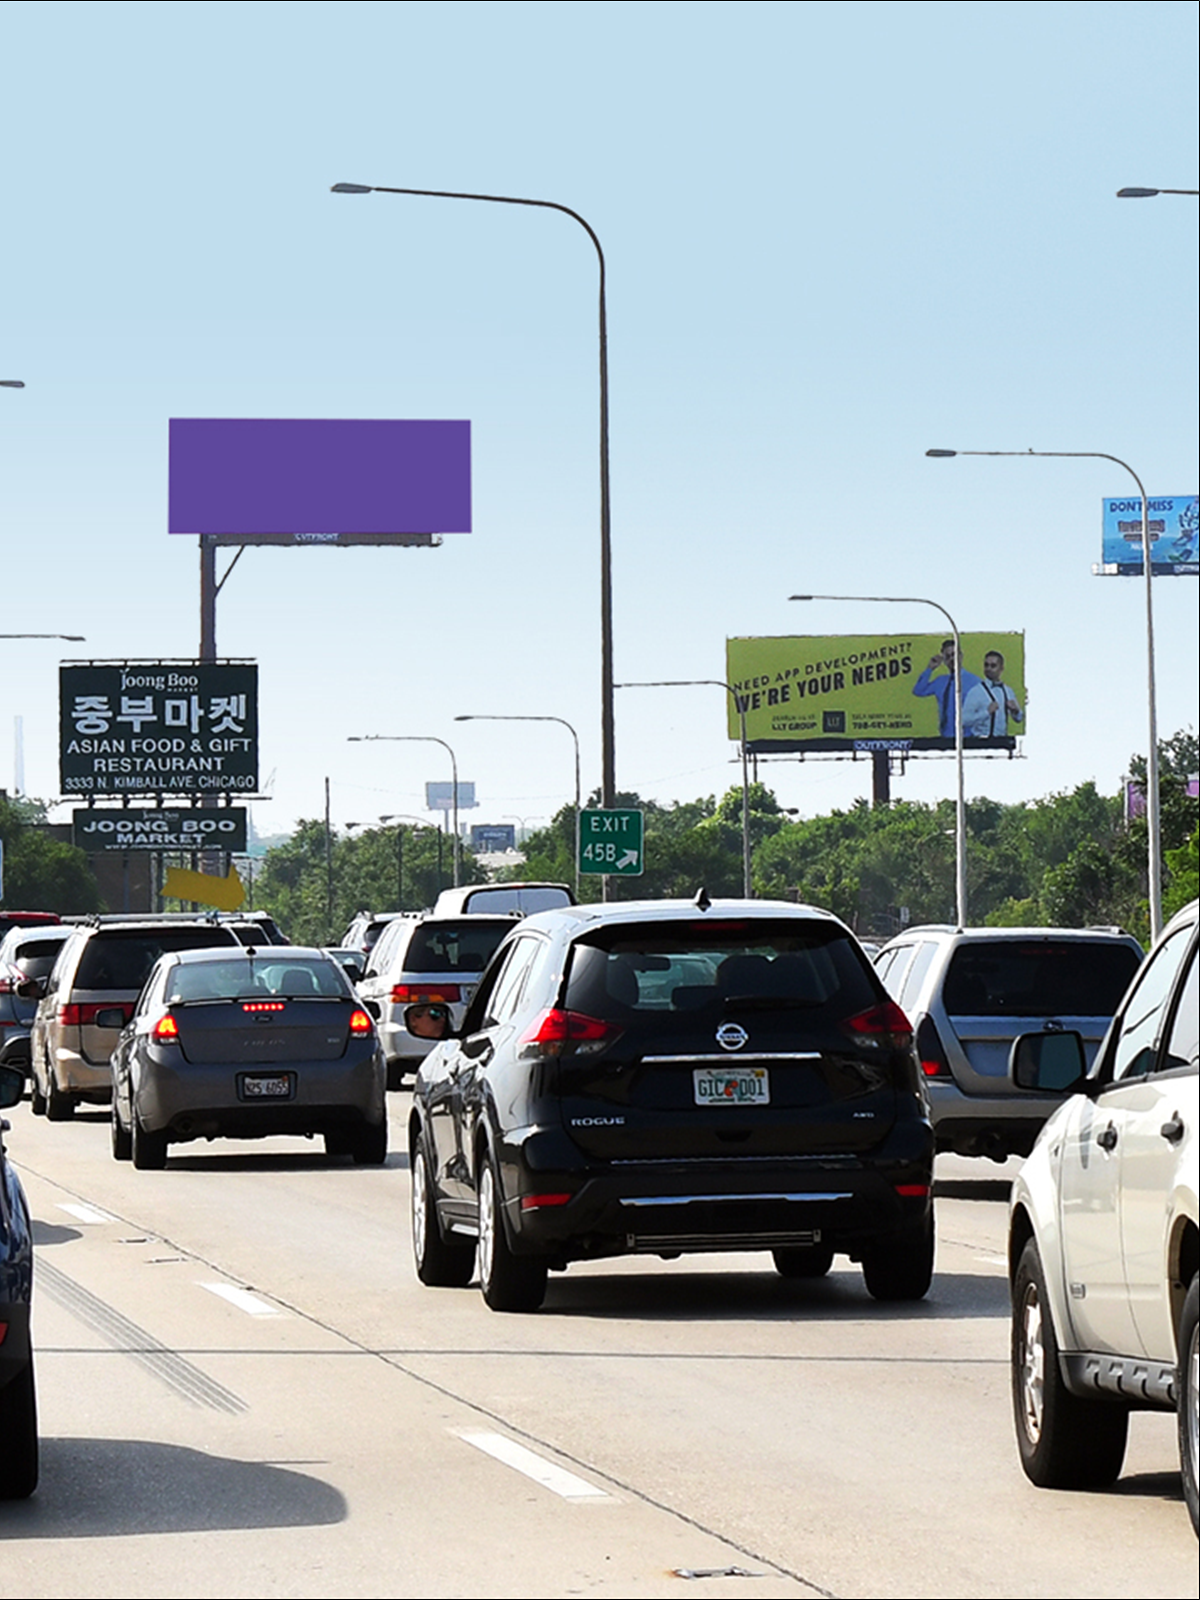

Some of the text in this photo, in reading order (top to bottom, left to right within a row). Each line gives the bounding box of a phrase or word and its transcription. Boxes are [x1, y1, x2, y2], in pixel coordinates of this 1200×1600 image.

[734, 642, 912, 691] NEED APP DEVELOPMENT?
[167, 673, 198, 687] Boo
[734, 656, 912, 714] WE'RE YOUR NERDS
[71, 694, 247, 734] 중부마켓
[67, 738, 252, 754] ASIAN FOOD & GIFT
[93, 757, 225, 772] RESTAURANT
[65, 777, 94, 790] 3333
[114, 776, 169, 789] KIMBALL
[198, 775, 255, 788] CHICAGO
[83, 819, 236, 833] JOONG BOO
[591, 816, 629, 831] EXIT
[116, 833, 206, 843] MARKET
[583, 843, 616, 862] 45B
[698, 1078, 725, 1097] GIC
[571, 1116, 625, 1126] ROGUE
